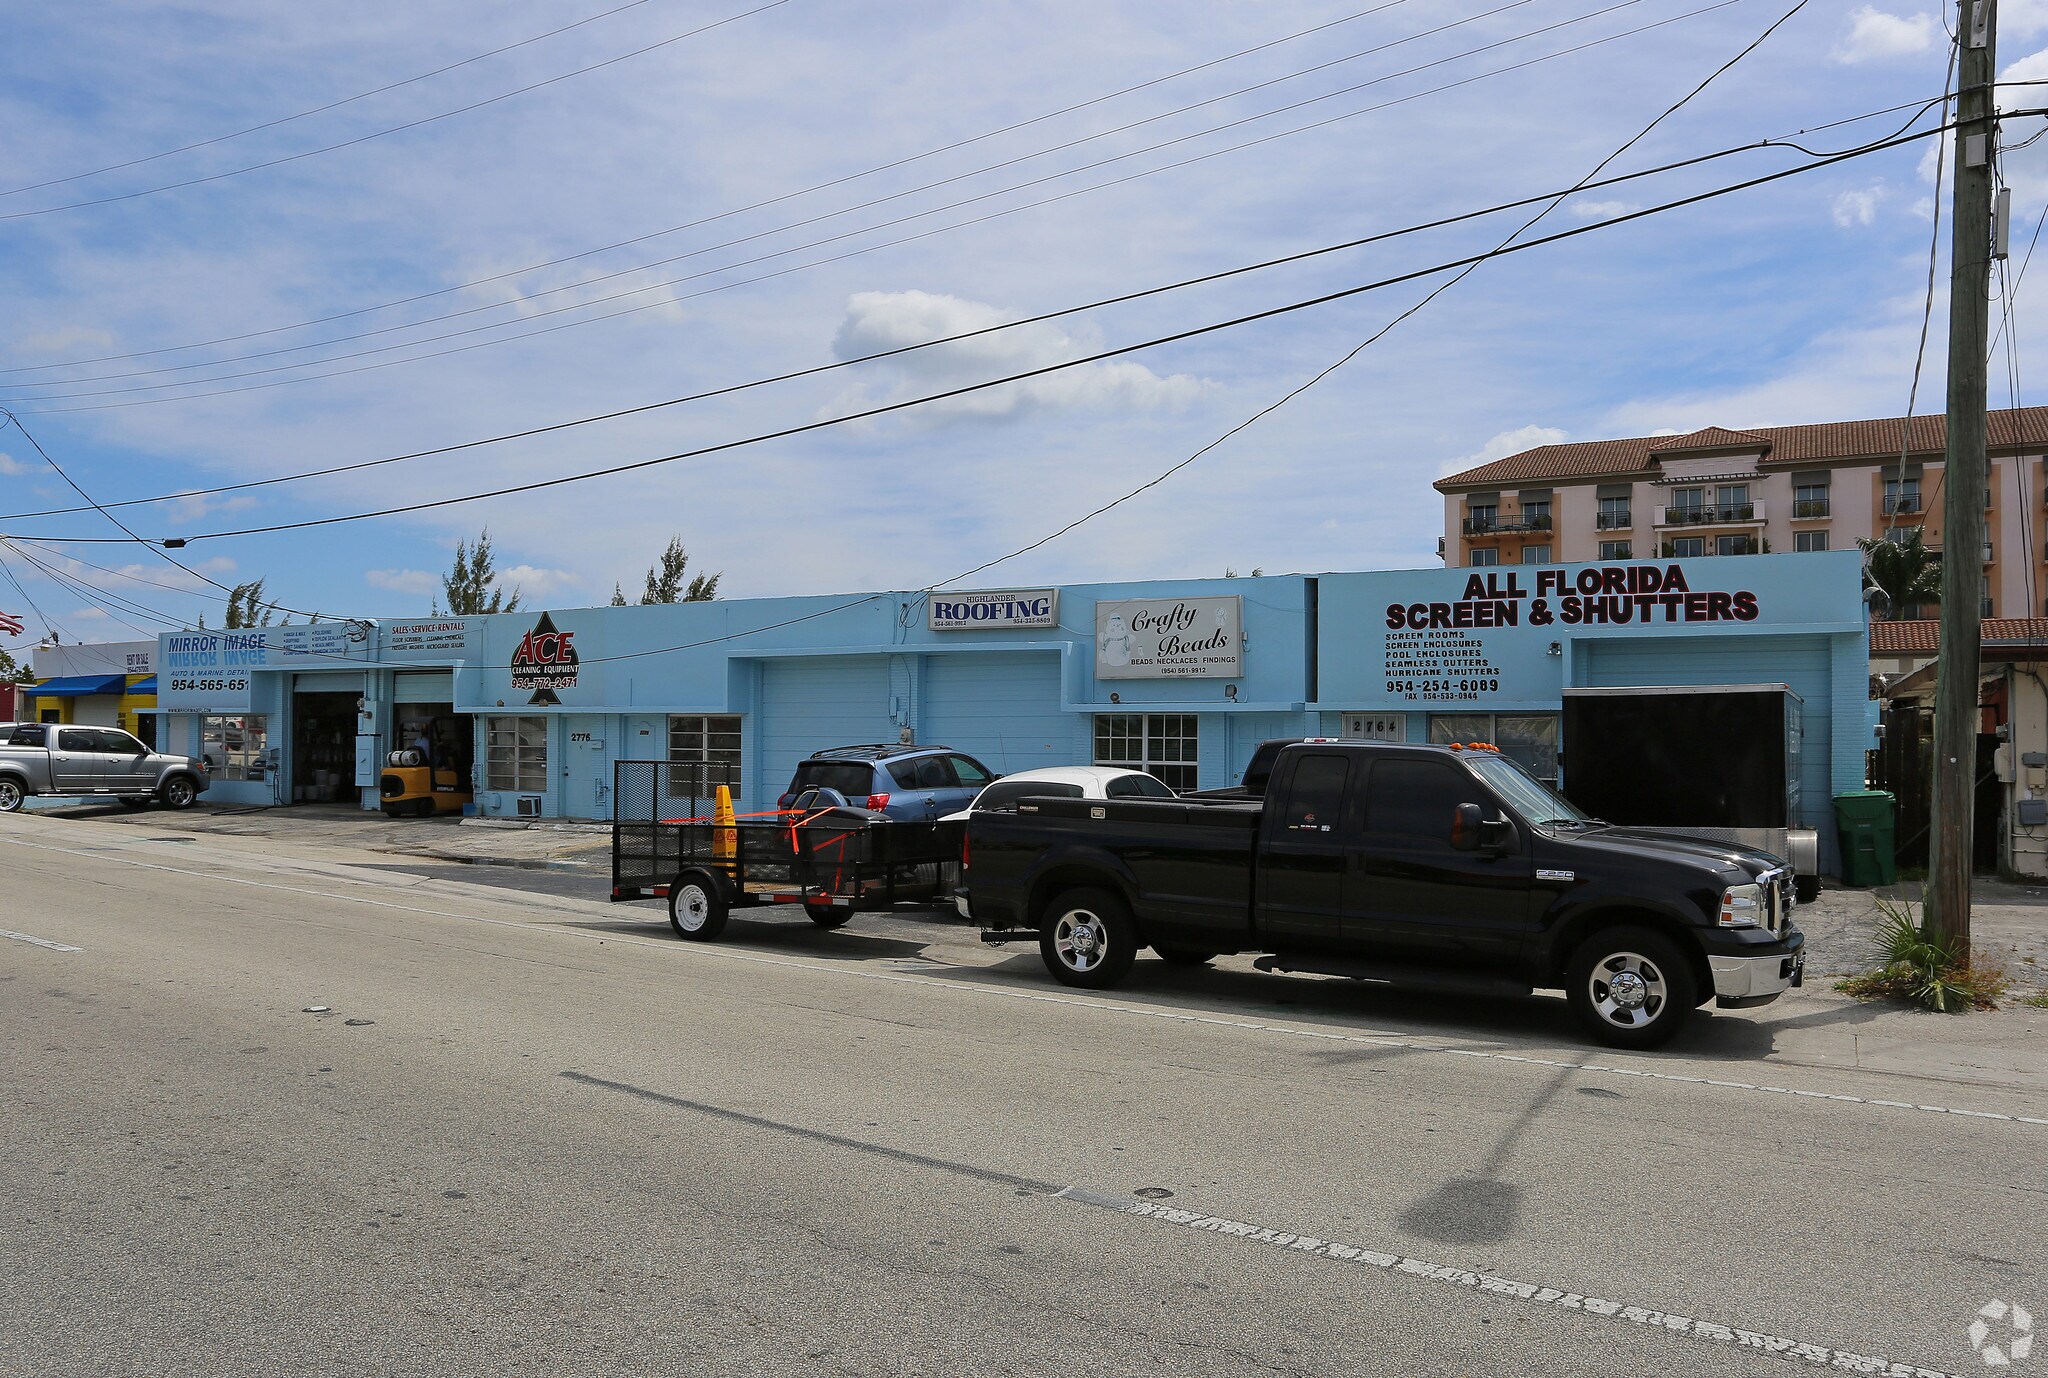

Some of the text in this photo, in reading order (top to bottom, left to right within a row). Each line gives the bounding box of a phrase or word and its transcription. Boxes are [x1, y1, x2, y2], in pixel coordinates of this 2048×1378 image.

[1462, 564, 1690, 600] ALL FLORIDA
[966, 594, 1016, 603] HIGHLANDER
[933, 597, 1051, 620] ROOFING
[1385, 591, 1759, 630] SCREEN & SHUTTERS
[1131, 602, 1198, 635] Crafty
[392, 622, 465, 634] SALES SERVICE RENTALS
[1385, 631, 1465, 640] SCREEN ROOMS
[168, 633, 267, 652] MIRROR IMAGE
[513, 628, 575, 664] ACE
[1157, 627, 1229, 658] Beads
[1385, 640, 1483, 649] SCREEN ENCLOSURES
[1416, 649, 1481, 657] ENCLOSURES
[1131, 656, 1236, 666] BEADS NECKLACES FINDINGS
[1385, 660, 1438, 668] SEAMLESS
[512, 664, 579, 675] CLEANING EQUIPMENT
[1447, 668, 1500, 676] SHUTTERS
[511, 676, 578, 689] 954-772-2471
[1386, 679, 1499, 693] 954-254-6089
[1354, 720, 1396, 732] 2764
[571, 733, 591, 742] 2776
